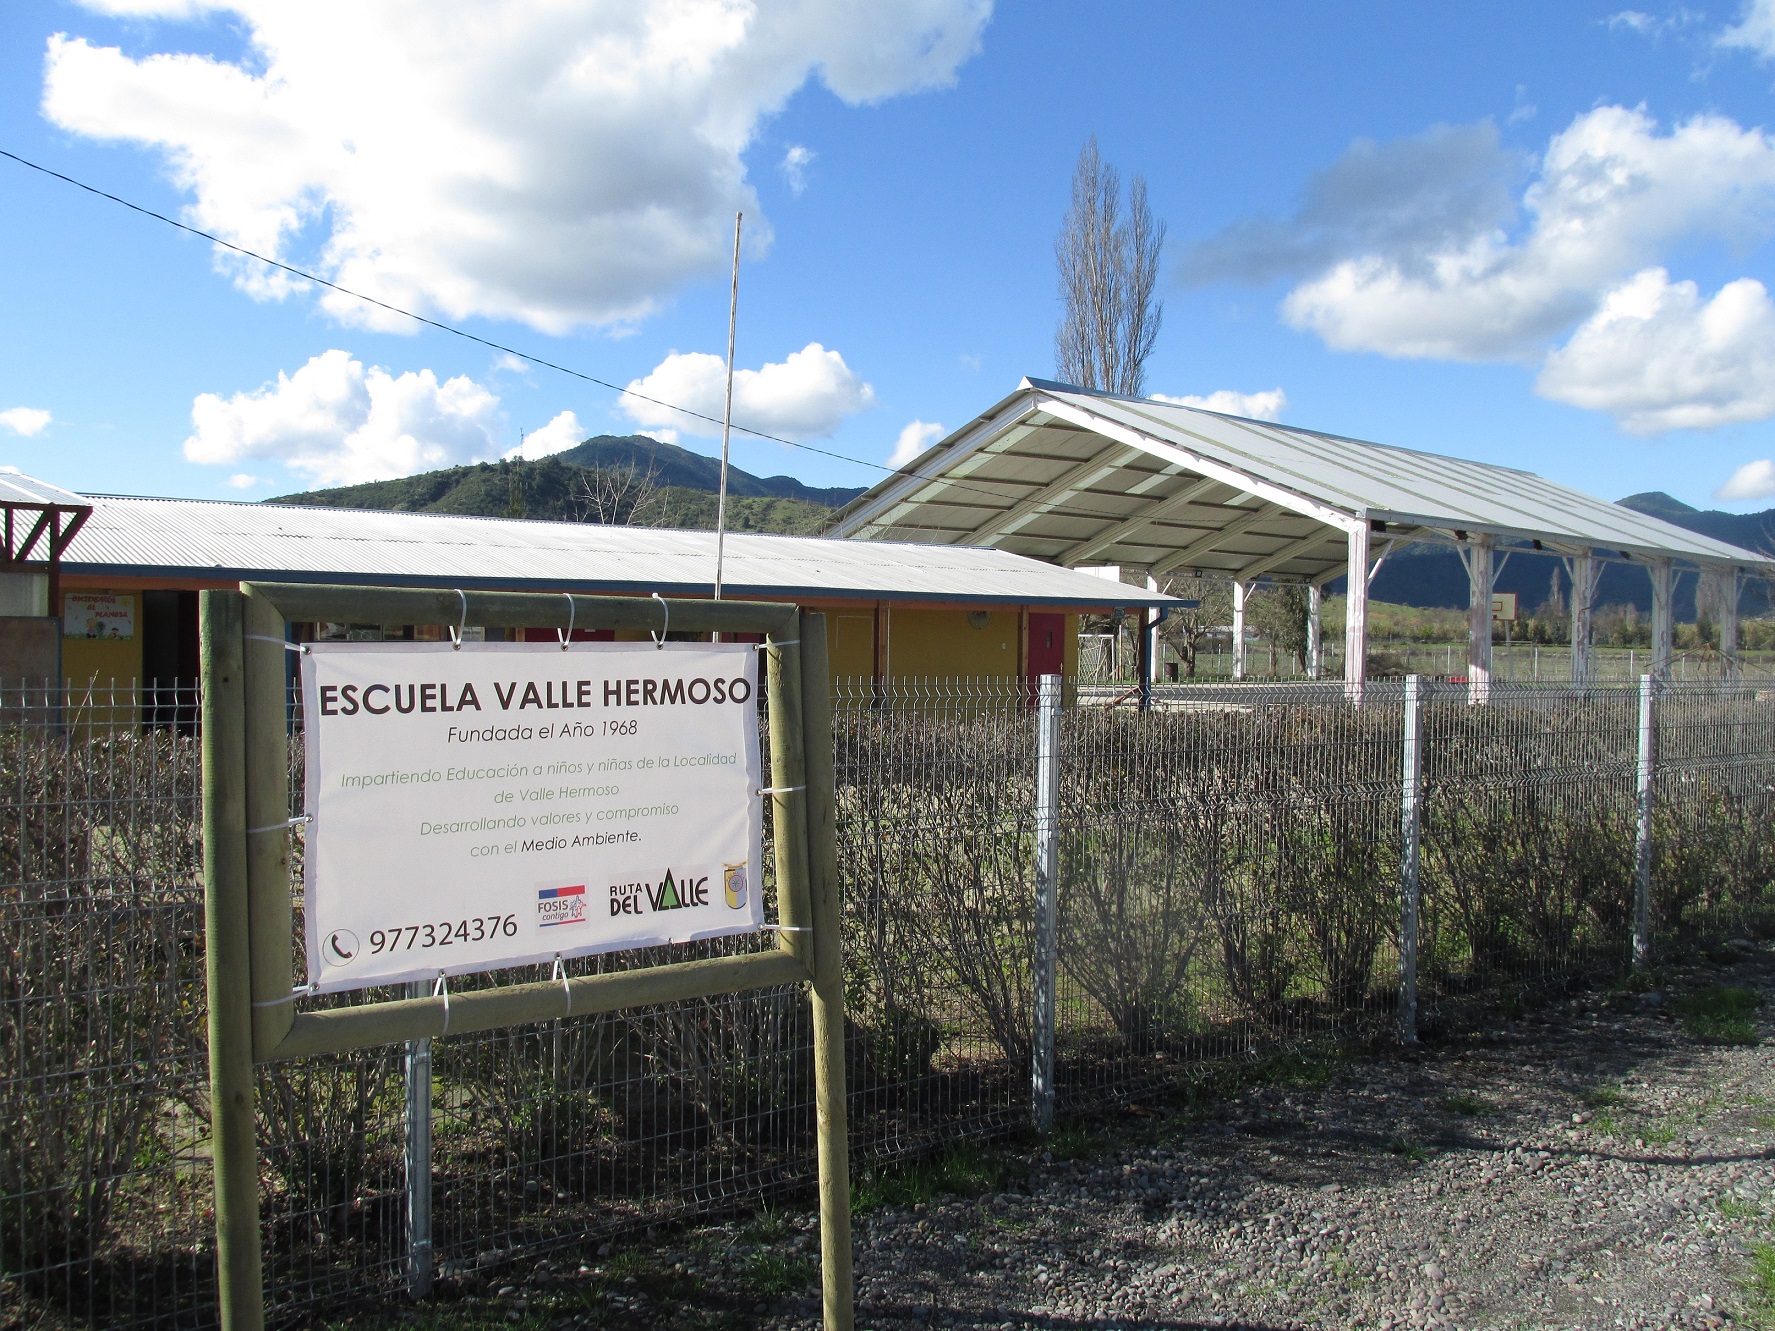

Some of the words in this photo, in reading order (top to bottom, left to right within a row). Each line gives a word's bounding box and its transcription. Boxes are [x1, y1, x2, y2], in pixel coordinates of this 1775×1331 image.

[320, 682, 481, 716] ESCUELA
[493, 680, 592, 711] VALLE
[603, 677, 752, 707] HERMOSO
[447, 725, 533, 744] Fundada
[538, 723, 555, 740] el
[559, 721, 595, 738] Año
[601, 720, 639, 737] 1968
[341, 769, 442, 789] Impartiendo
[446, 763, 528, 782] Educación
[532, 765, 543, 776] a
[546, 758, 583, 775] niños
[586, 762, 595, 775] y
[598, 756, 635, 772] niñas
[636, 756, 655, 770] de
[657, 755, 671, 768] la
[674, 752, 738, 767] Localidad
[493, 790, 514, 804] de
[519, 787, 556, 802] Valle
[558, 783, 620, 799] Hermoso
[420, 814, 527, 836] Desarrollando
[531, 811, 582, 827] valores
[585, 811, 593, 824] y
[596, 803, 680, 824] compromiso
[470, 843, 501, 857] con
[504, 841, 519, 855] el
[521, 837, 567, 853] Medio
[571, 829, 643, 848] Ambiente.
[609, 883, 643, 896] RUTA
[609, 895, 643, 917] DEL
[645, 867, 709, 912] VALLE
[537, 900, 569, 914] FOSIS
[541, 911, 569, 921] contigo
[369, 914, 519, 956] 977324376
